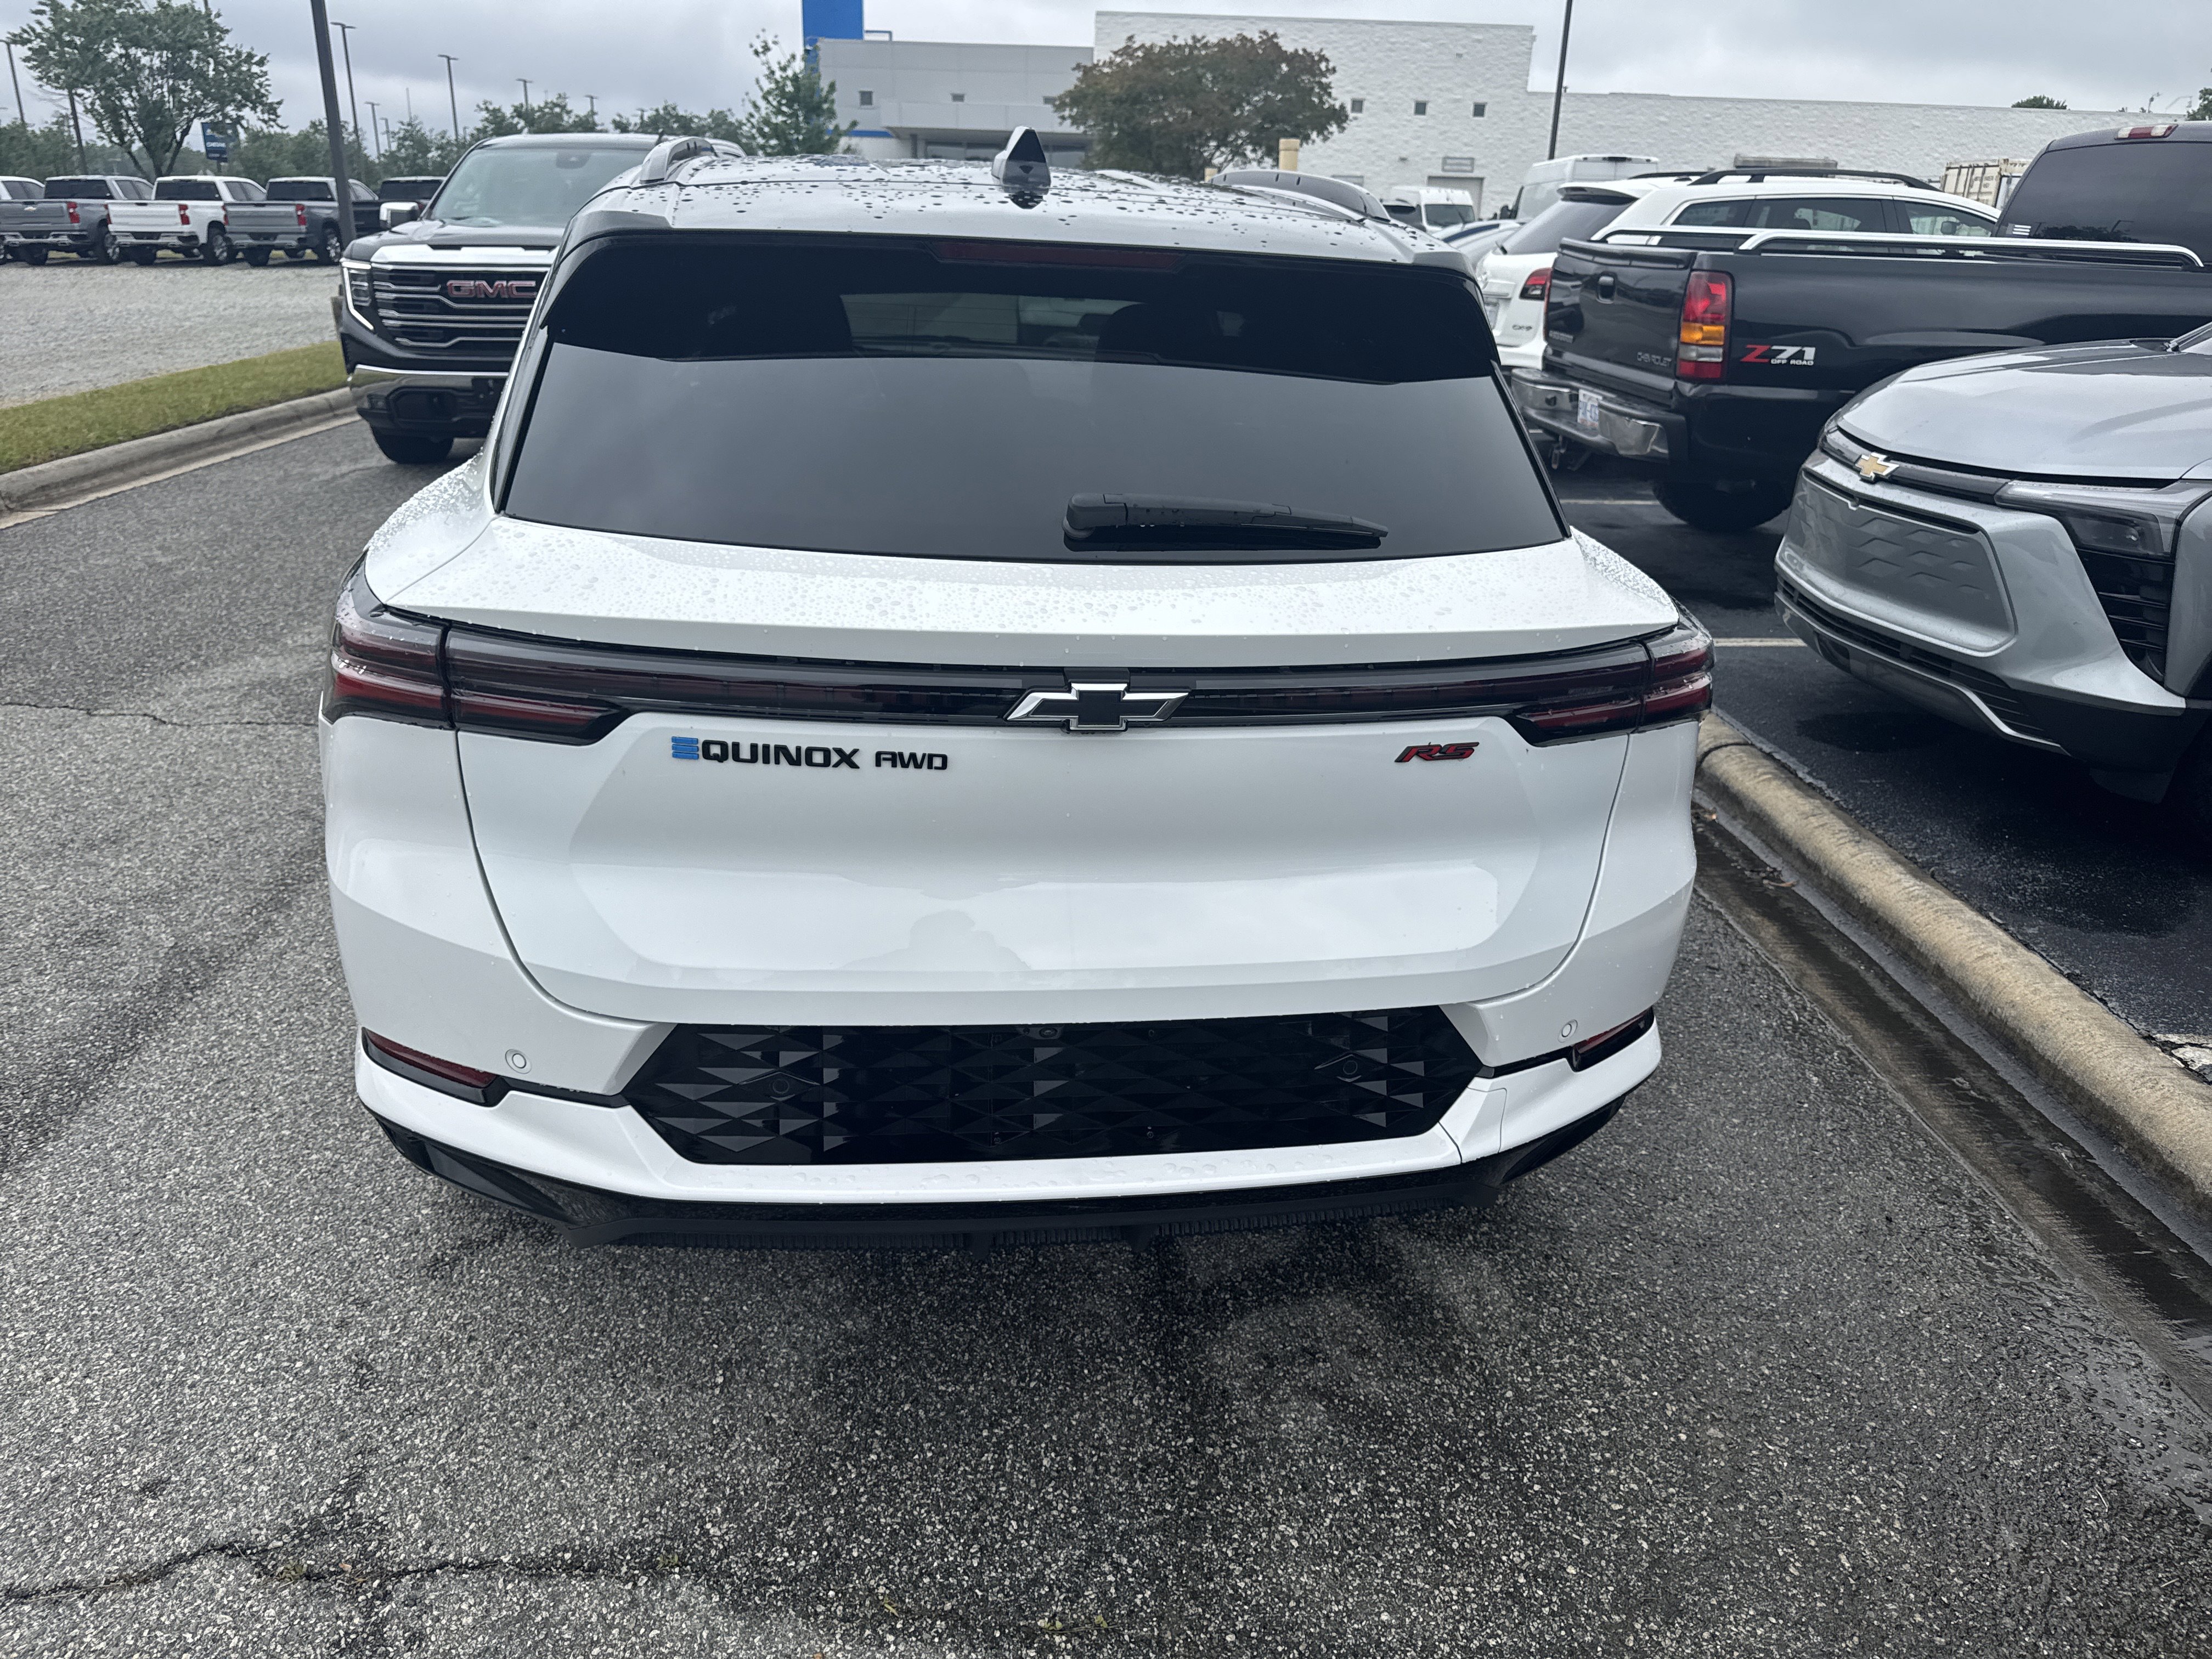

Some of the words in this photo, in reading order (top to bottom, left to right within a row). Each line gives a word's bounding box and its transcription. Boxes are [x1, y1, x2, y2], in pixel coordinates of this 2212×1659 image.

[447, 280, 537, 298] GMC
[1740, 344, 1816, 363] Z71
[672, 736, 860, 769] EQUINOX
[875, 751, 948, 770] AWD
[1395, 742, 1480, 762] RS
